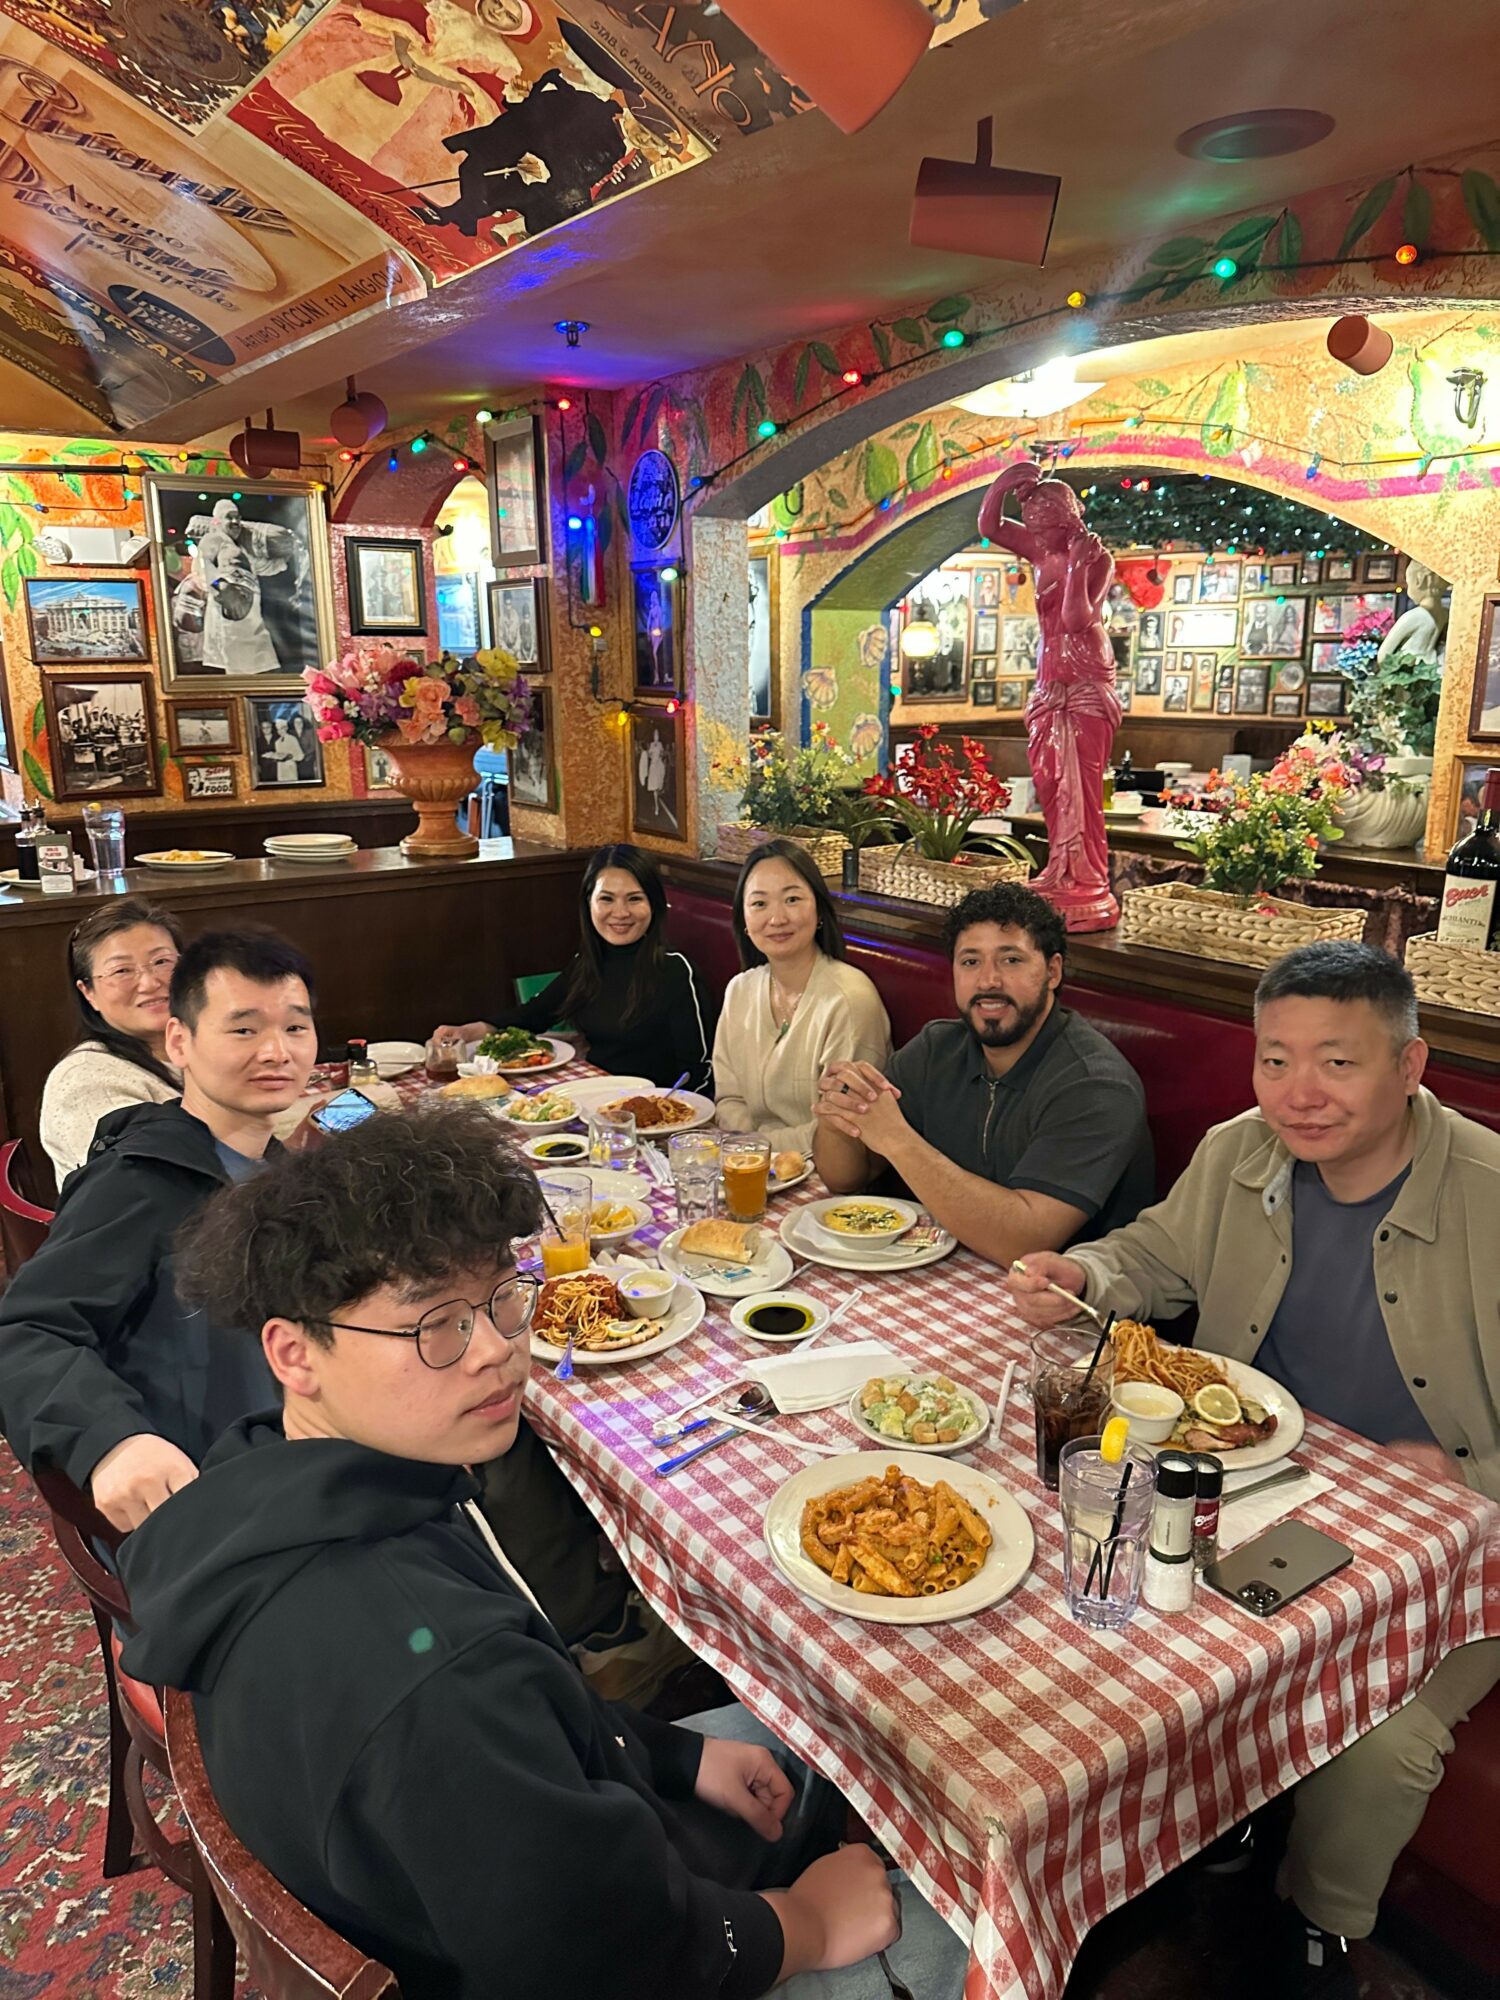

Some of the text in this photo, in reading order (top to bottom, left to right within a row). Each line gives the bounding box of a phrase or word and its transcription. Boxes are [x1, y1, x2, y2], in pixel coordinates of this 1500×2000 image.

[629, 58, 674, 101] MODIANO
[56, 183, 184, 249] Arturo
[19, 265, 47, 284] AL
[48, 280, 208, 384] MARSALA
[270, 297, 330, 334] PICCINI
[204, 782, 233, 794] FOOD!
